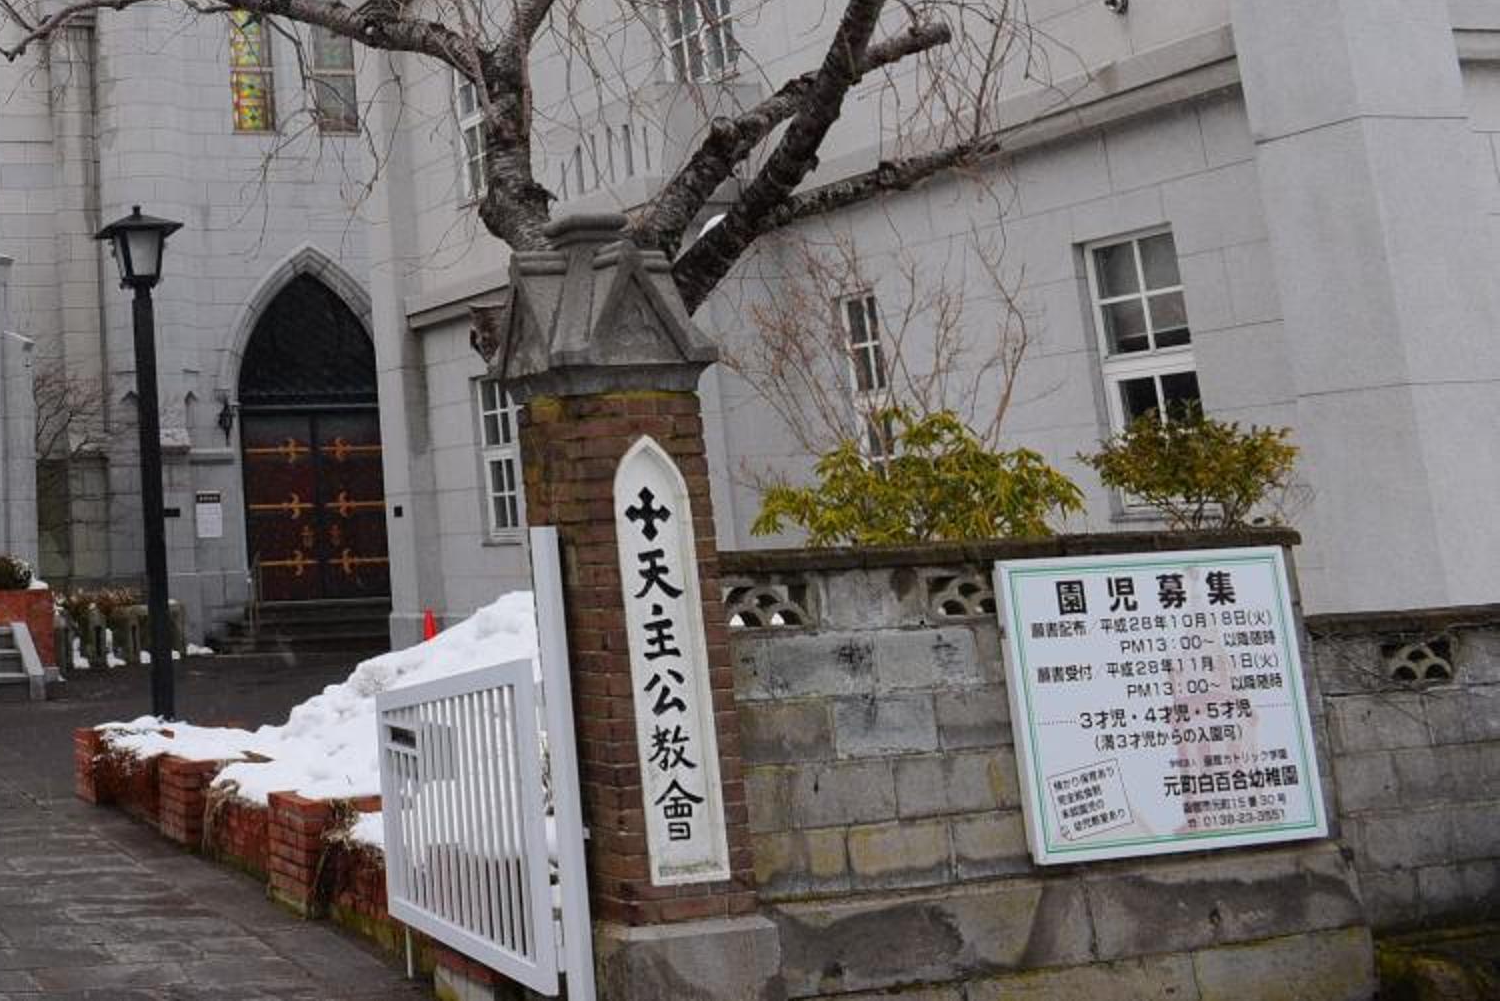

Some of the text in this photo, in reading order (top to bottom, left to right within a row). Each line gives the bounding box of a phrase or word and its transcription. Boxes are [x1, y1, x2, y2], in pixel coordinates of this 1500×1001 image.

[1055, 570, 1236, 616] 園児募集
[633, 548, 705, 841] 天主公教會
[1164, 764, 1298, 797] 元町白百合幼稚園
